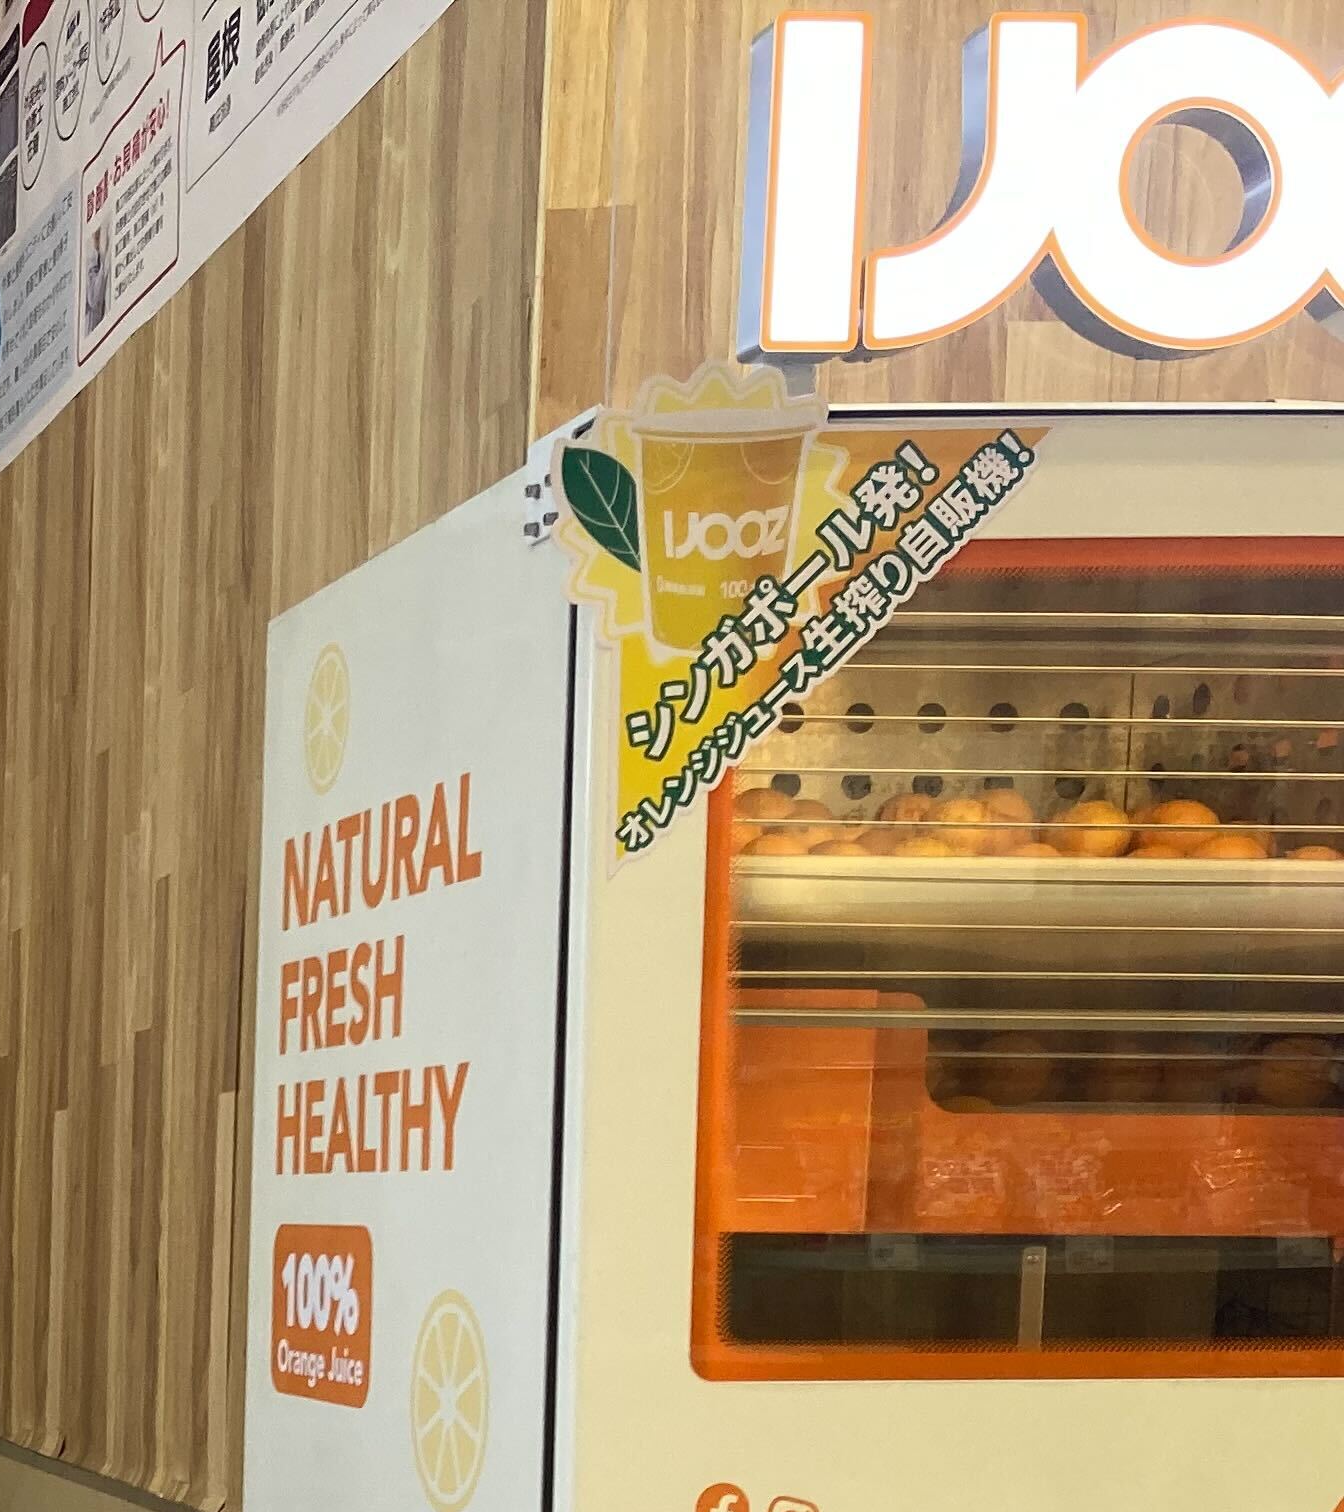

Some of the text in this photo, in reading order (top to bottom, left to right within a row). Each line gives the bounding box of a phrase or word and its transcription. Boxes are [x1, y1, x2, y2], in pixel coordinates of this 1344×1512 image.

[205, 6, 241, 104] 屋根
[736, 10, 1344, 362] IJO
[664, 505, 789, 560] IJOOZ
[282, 772, 483, 931] NATURAL
[279, 935, 404, 1055] FRESH
[275, 1061, 470, 1175] HEALTHY
[281, 1252, 358, 1336] 100%
[277, 1337, 363, 1387] Orange Juice
